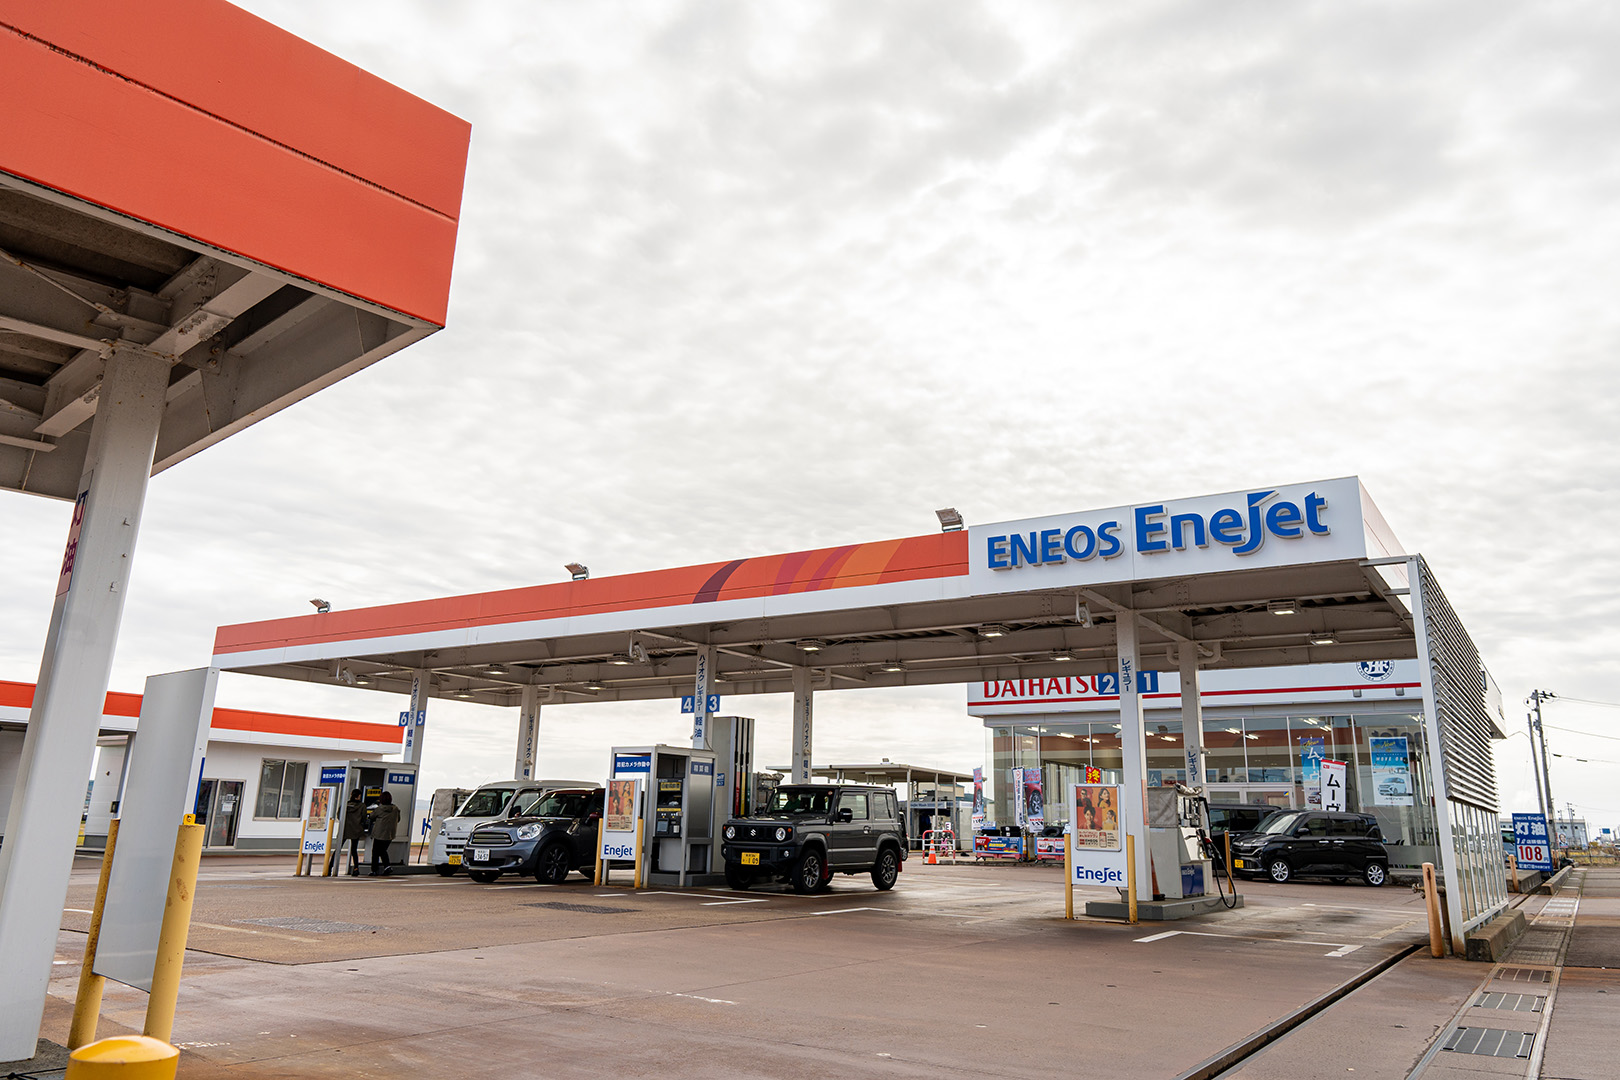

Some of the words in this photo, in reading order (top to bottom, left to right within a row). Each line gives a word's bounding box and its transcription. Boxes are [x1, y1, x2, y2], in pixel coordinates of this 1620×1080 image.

[987, 520, 1124, 570] ENEOS
[1121, 657, 1132, 692] レギュラー
[1143, 672, 1152, 692] 1
[1102, 674, 1116, 694] 2
[683, 697, 693, 712] 4
[708, 695, 718, 712] 3
[400, 712, 408, 726] 6
[417, 711, 424, 725] 5
[694, 716, 703, 738] 軽油
[1188, 751, 1198, 782] レギュラー
[1515, 821, 1547, 836] 灯油
[1518, 845, 1543, 861] 108
